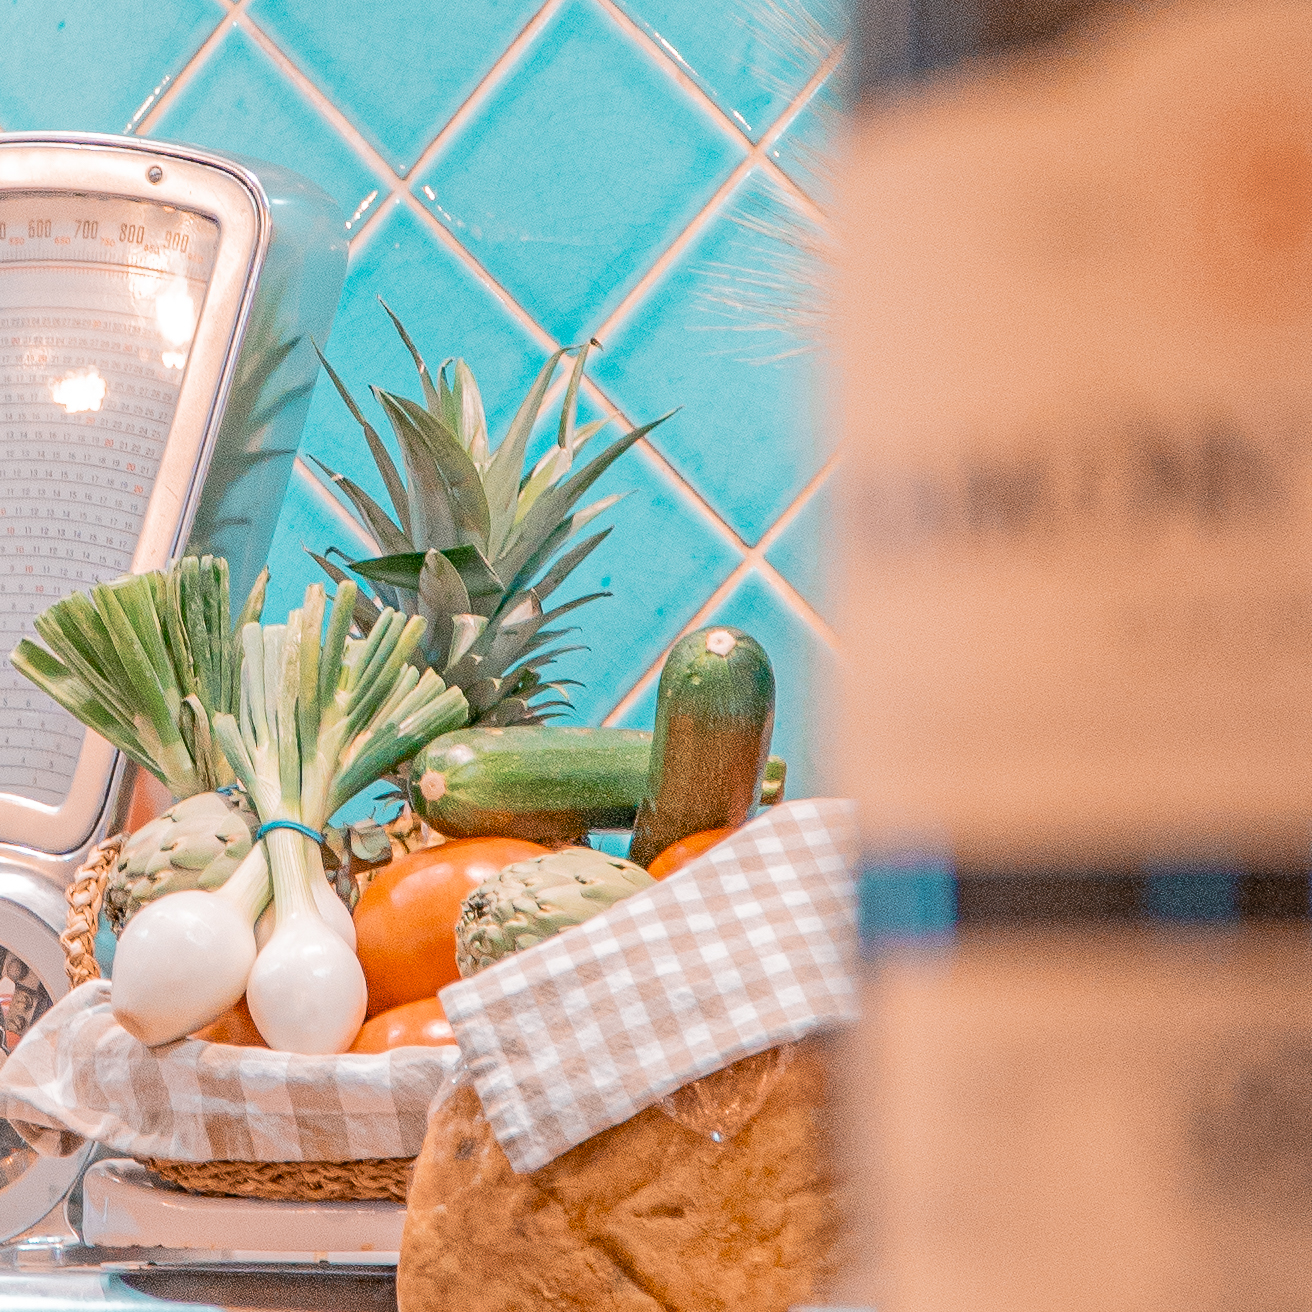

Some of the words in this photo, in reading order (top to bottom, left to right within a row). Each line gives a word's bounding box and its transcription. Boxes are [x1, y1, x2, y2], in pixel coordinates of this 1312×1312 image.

[28, 218, 52, 238] 600
[74, 219, 99, 240] 700
[118, 223, 146, 245] 800
[163, 230, 190, 254] 900
